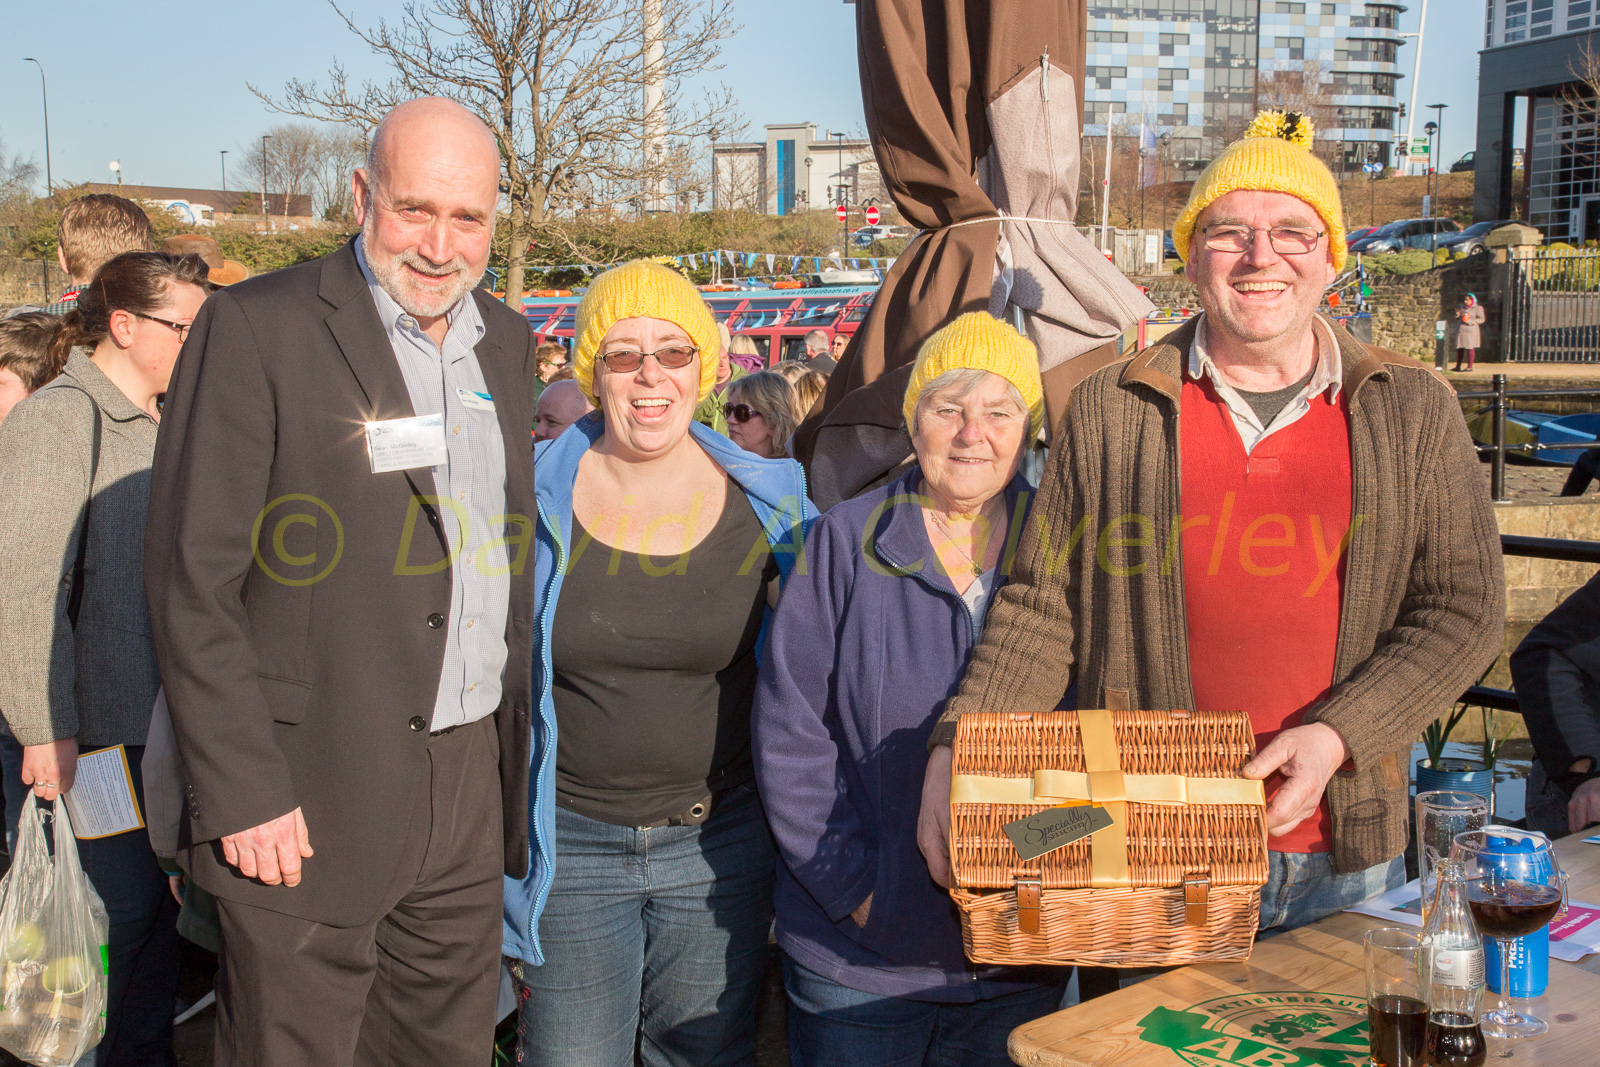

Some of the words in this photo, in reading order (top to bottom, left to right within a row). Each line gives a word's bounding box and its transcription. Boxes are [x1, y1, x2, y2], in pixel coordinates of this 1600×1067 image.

[1024, 806, 1093, 846] Specially
[1047, 822, 1085, 841] SELECTED
[1508, 938, 1517, 969] PRE
